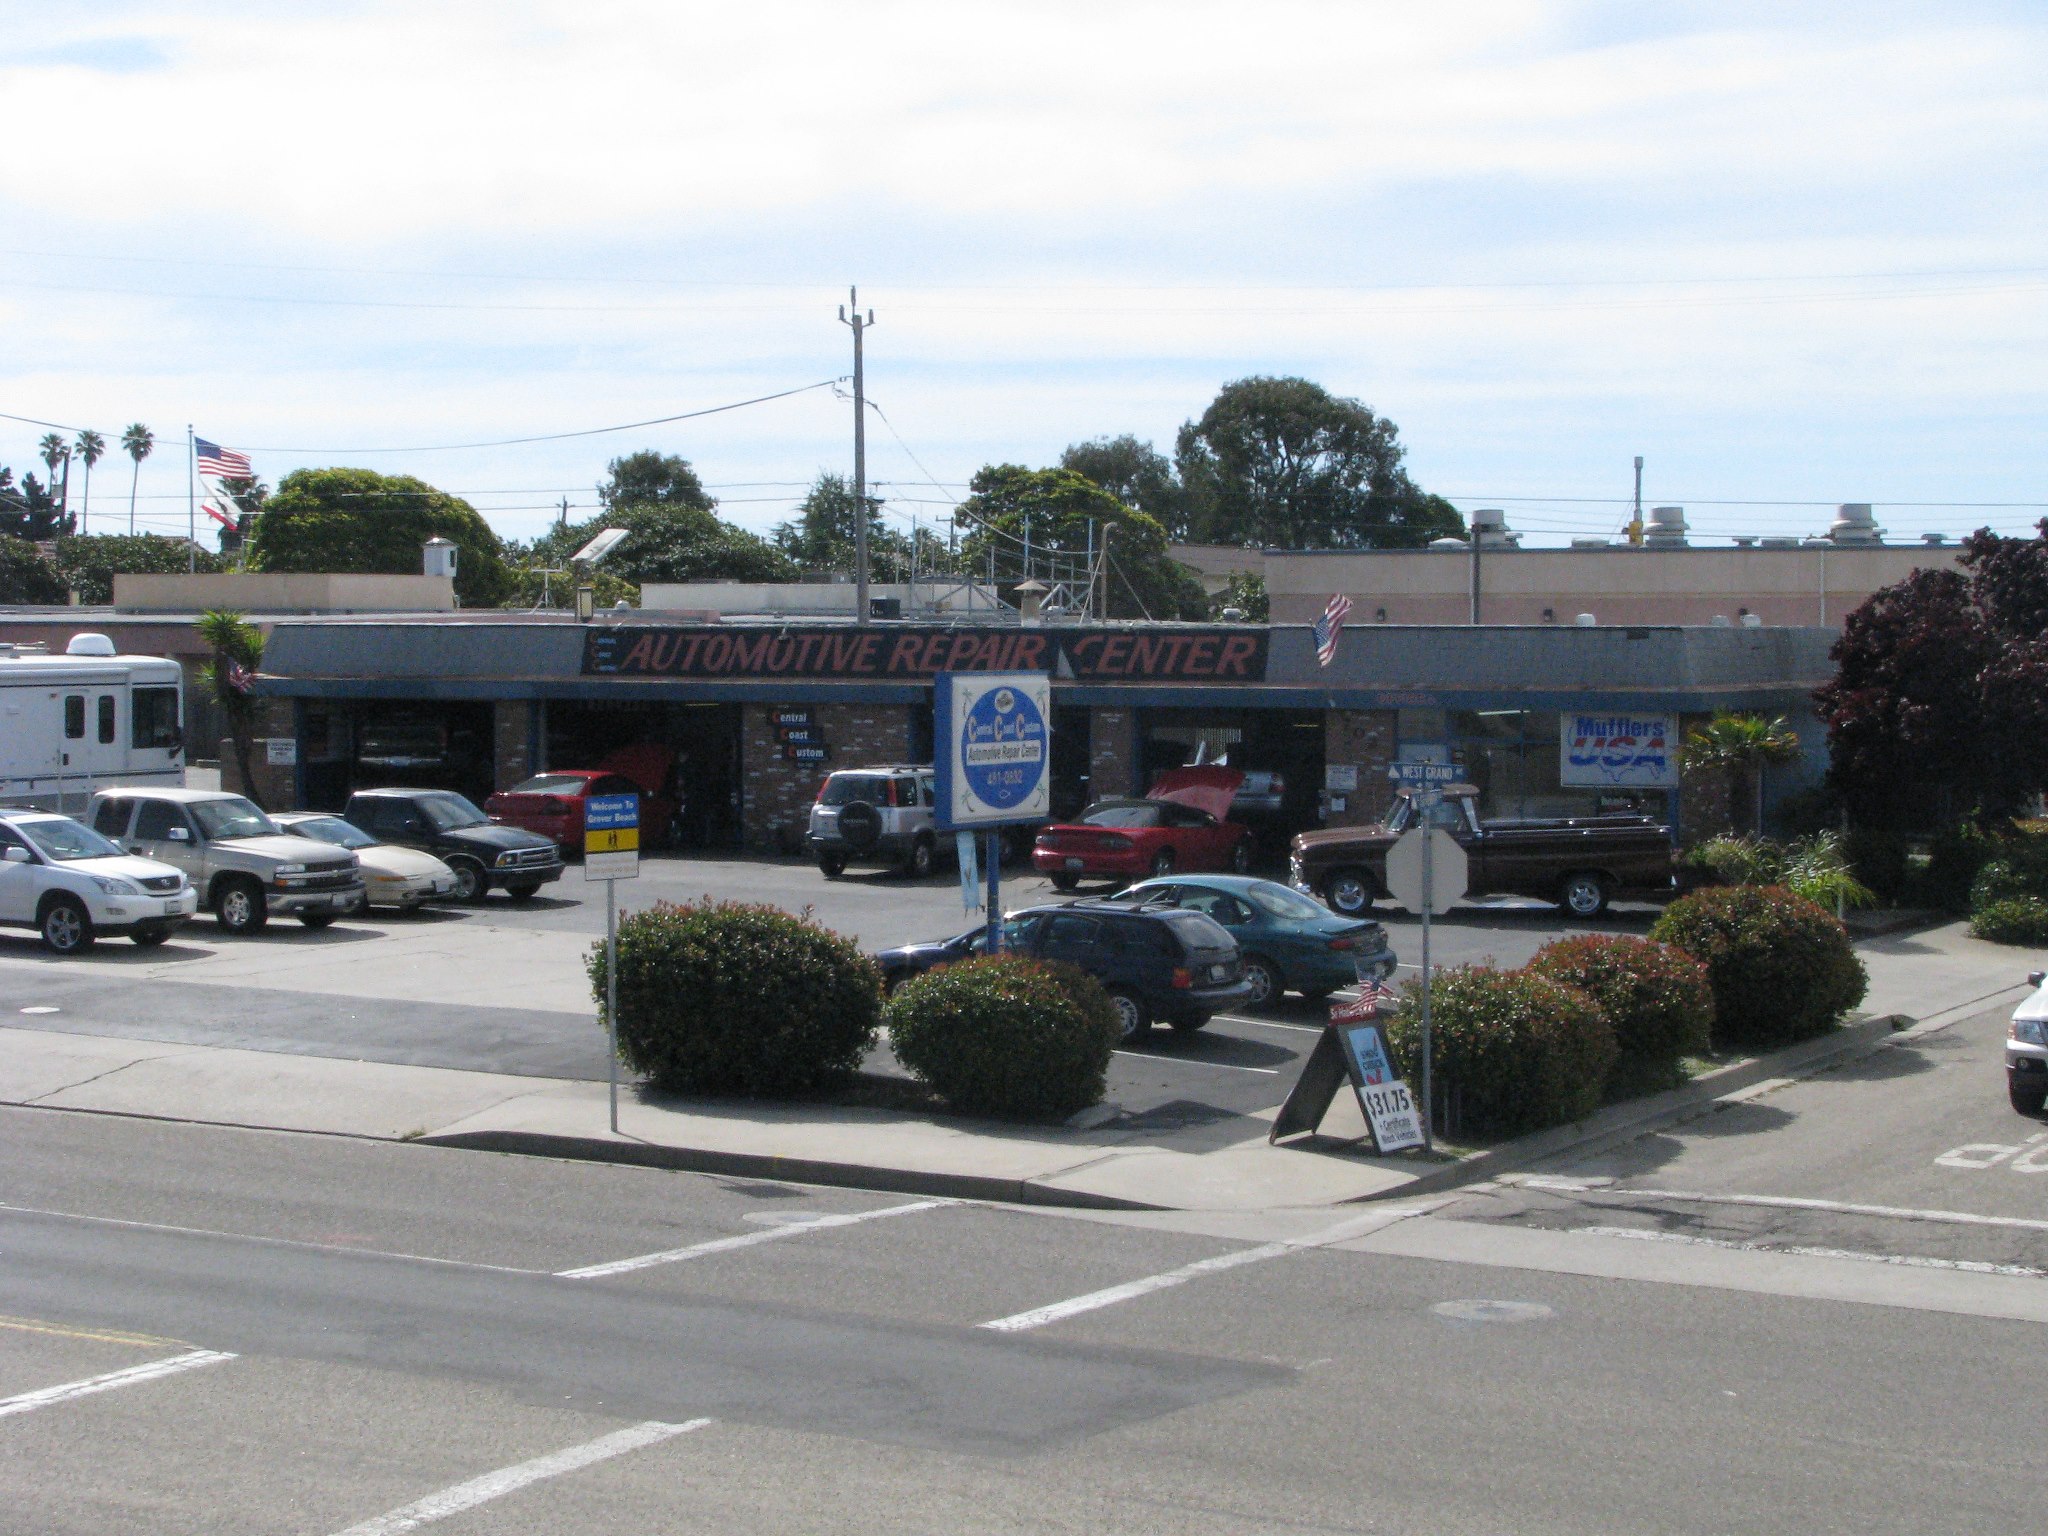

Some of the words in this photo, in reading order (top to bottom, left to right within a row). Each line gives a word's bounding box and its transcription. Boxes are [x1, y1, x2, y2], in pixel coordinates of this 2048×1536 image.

[620, 633, 884, 672] AUTOMOTIVE
[886, 633, 1047, 672] REPAIR
[1072, 634, 1257, 675] CENTER
[1576, 716, 1664, 737] Mufflers
[1568, 736, 1666, 767] USA
[1402, 765, 1422, 779] WEST
[1425, 766, 1453, 780] GRAND
[591, 802, 622, 811] Welcome
[625, 800, 634, 809] To
[587, 814, 612, 823] Grover
[614, 812, 637, 822] Beach
[1366, 1088, 1410, 1120] $31.75
